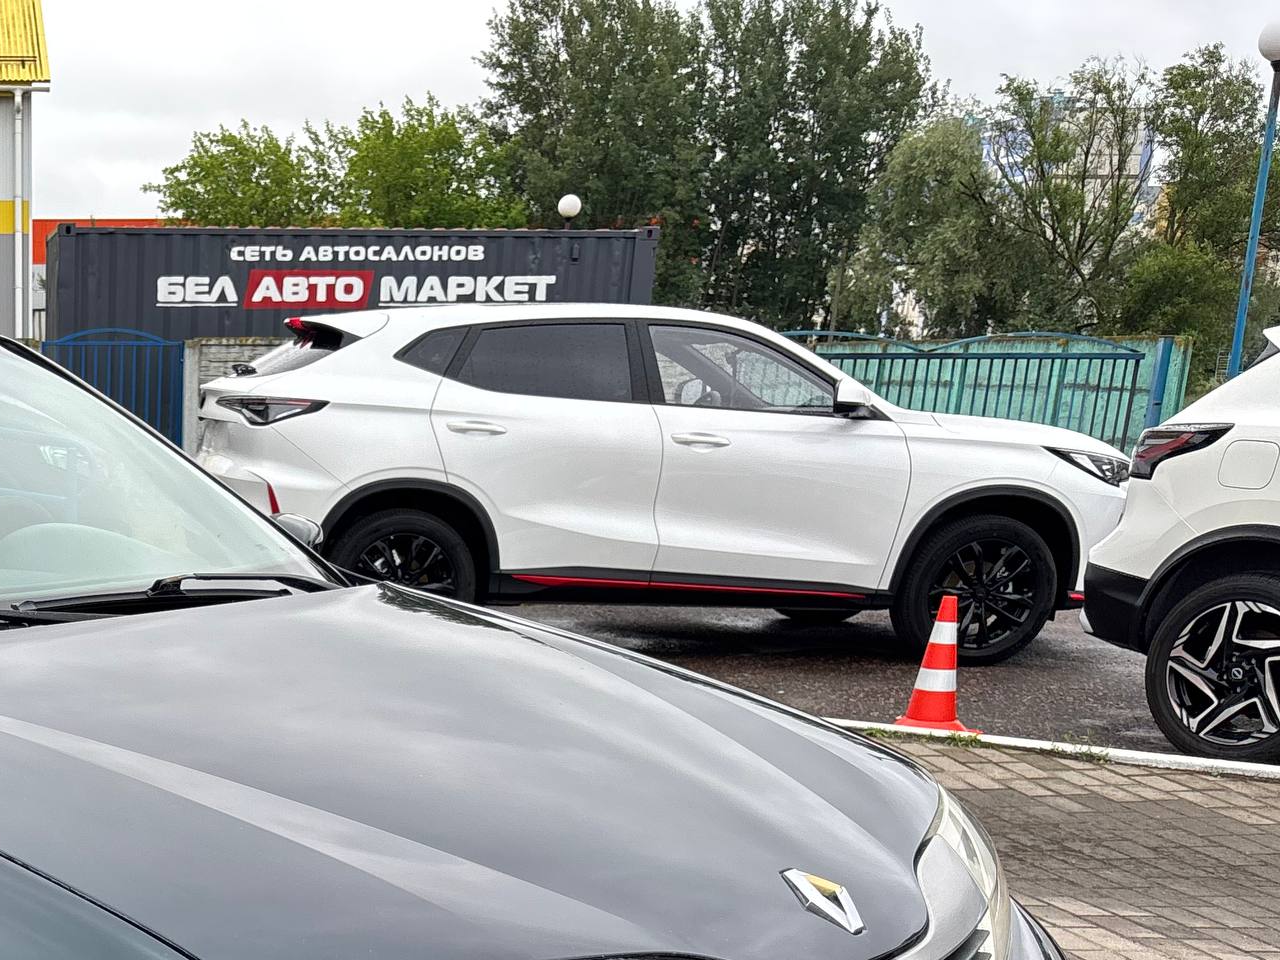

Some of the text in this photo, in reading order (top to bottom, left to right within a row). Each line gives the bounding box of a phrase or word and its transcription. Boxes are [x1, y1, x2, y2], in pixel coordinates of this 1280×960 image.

[230, 244, 485, 262] СЕТЬ АВТОСАЛОНОВ
[156, 274, 557, 303] БЕЛ АВТО МАРКЕТ
